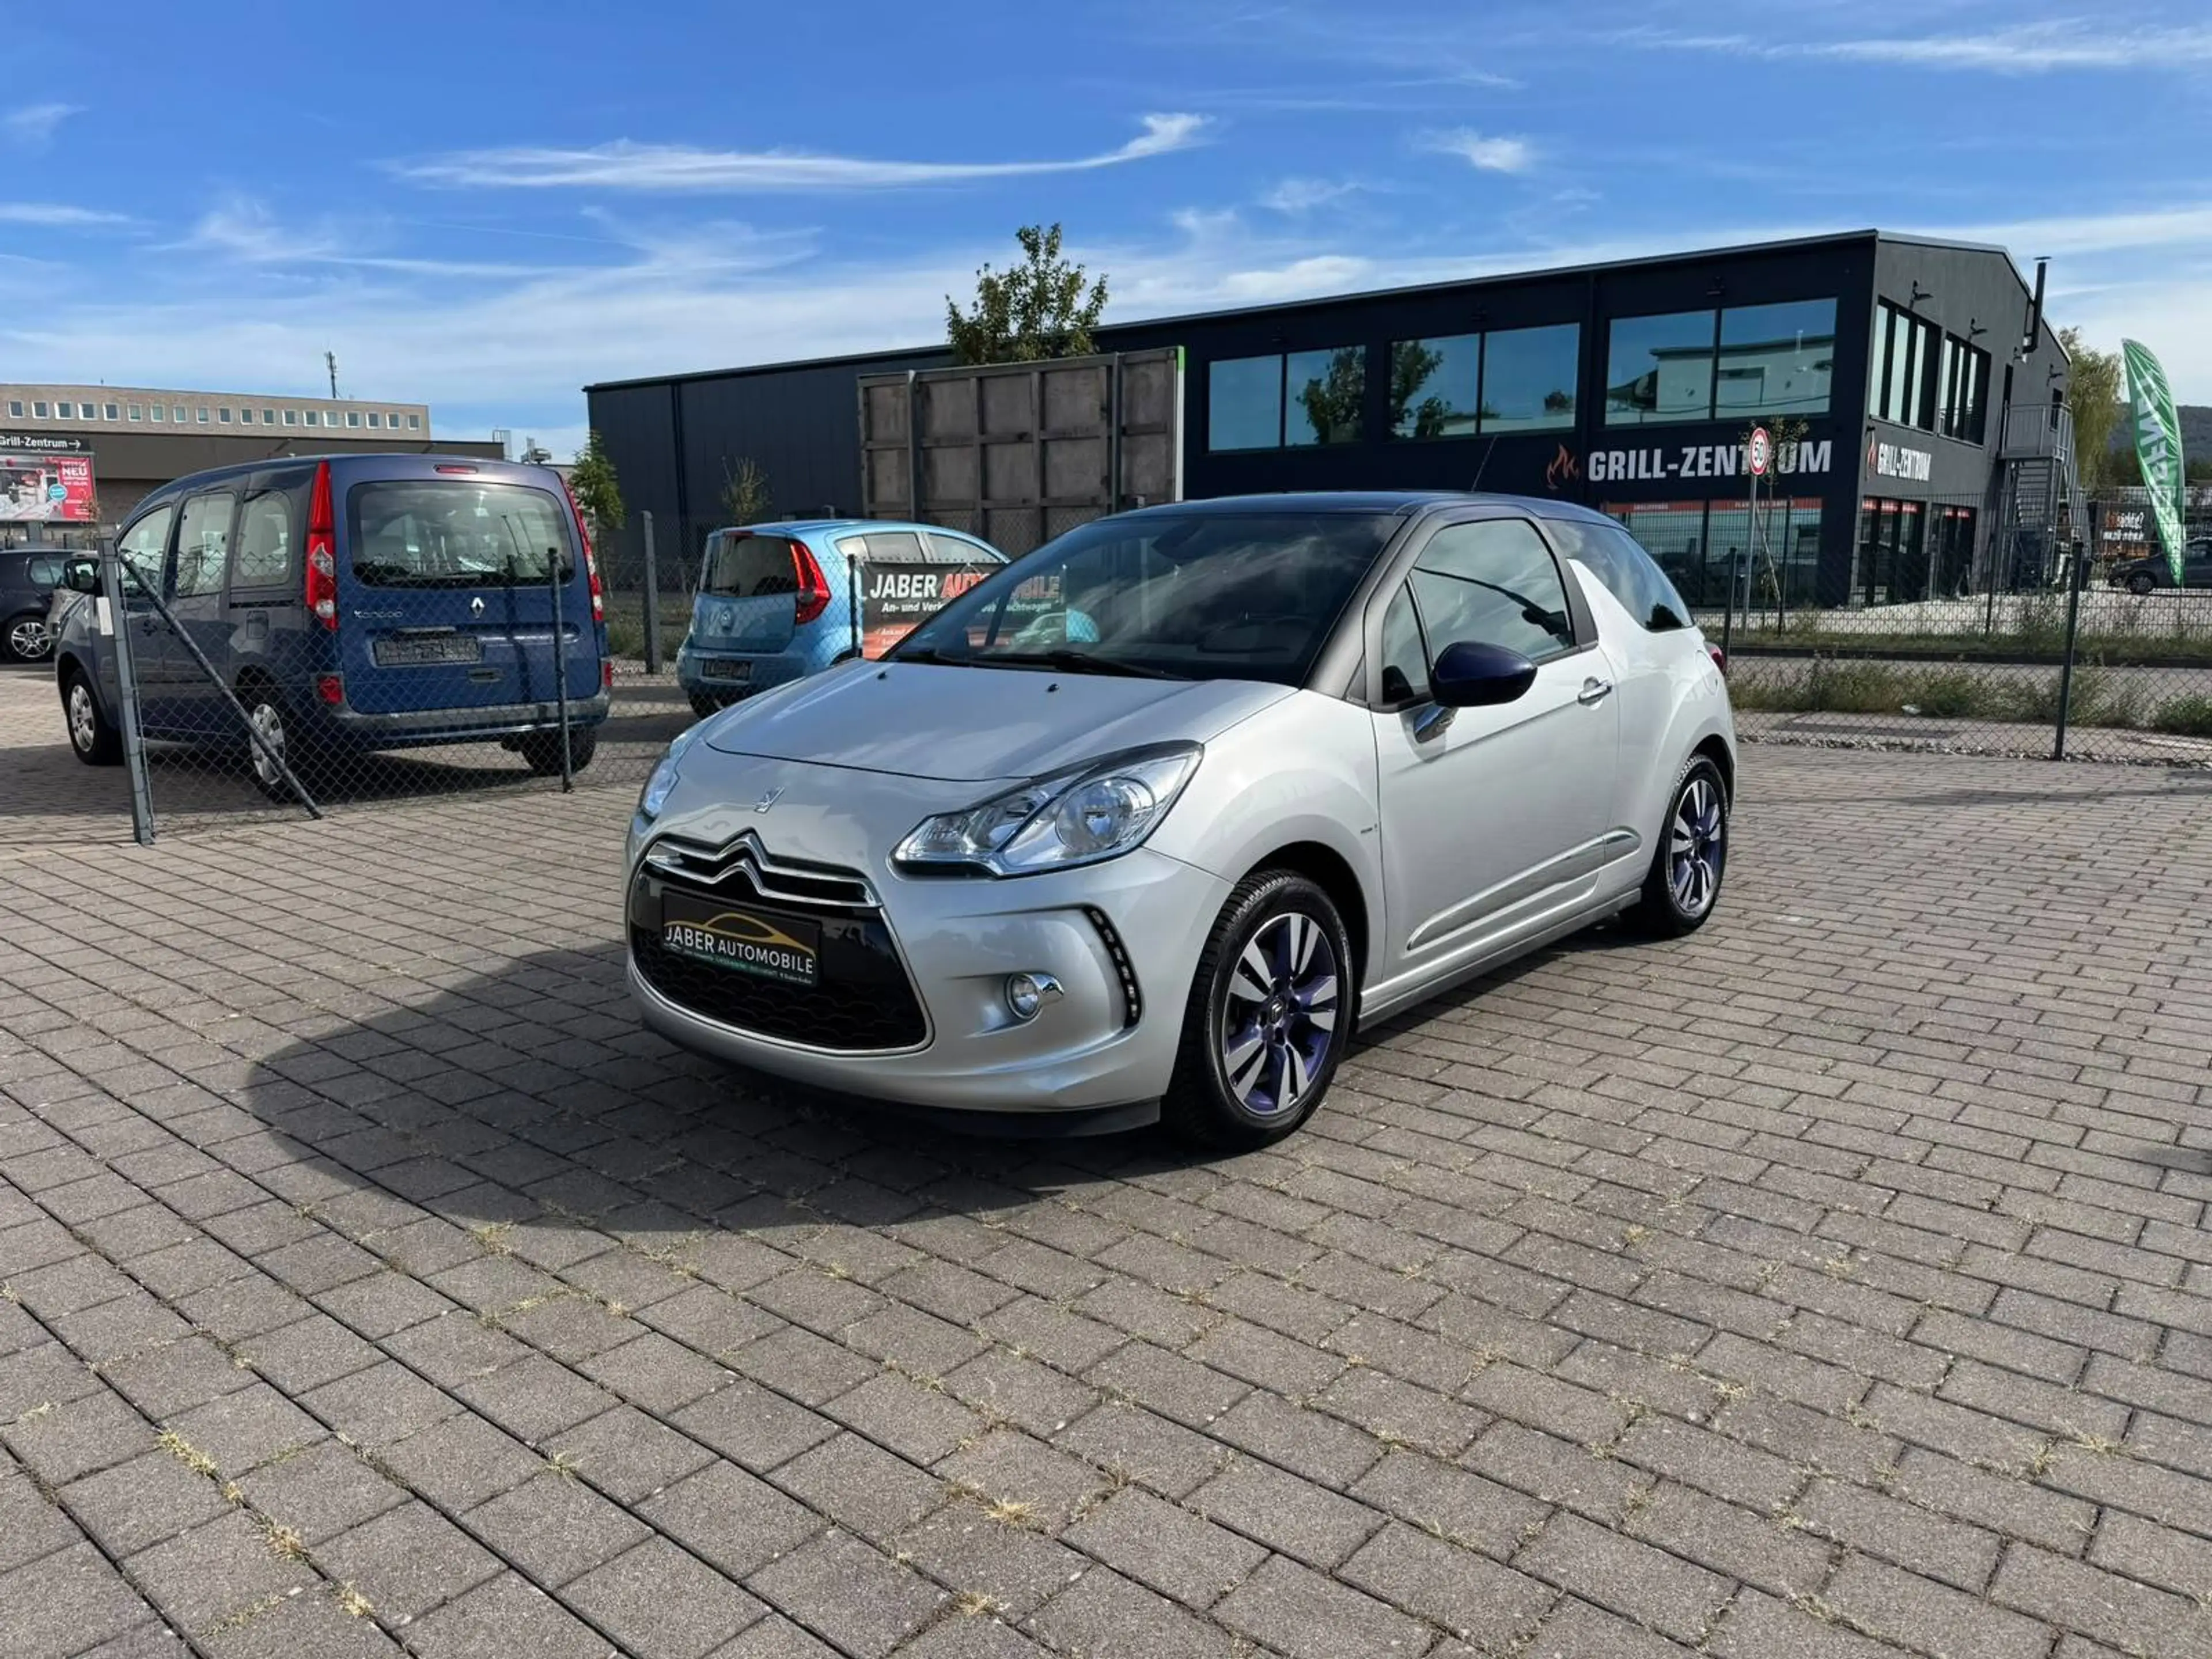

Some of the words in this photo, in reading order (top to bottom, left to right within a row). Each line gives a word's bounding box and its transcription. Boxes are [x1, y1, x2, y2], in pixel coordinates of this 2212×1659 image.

[62, 467, 87, 476] NEU
[1588, 441, 1833, 482] GRILL-ZENTUM
[869, 574, 938, 599] JABER
[902, 602, 920, 612] und
[665, 926, 715, 953] JABER
[718, 939, 813, 974] AUTOMOBILE
